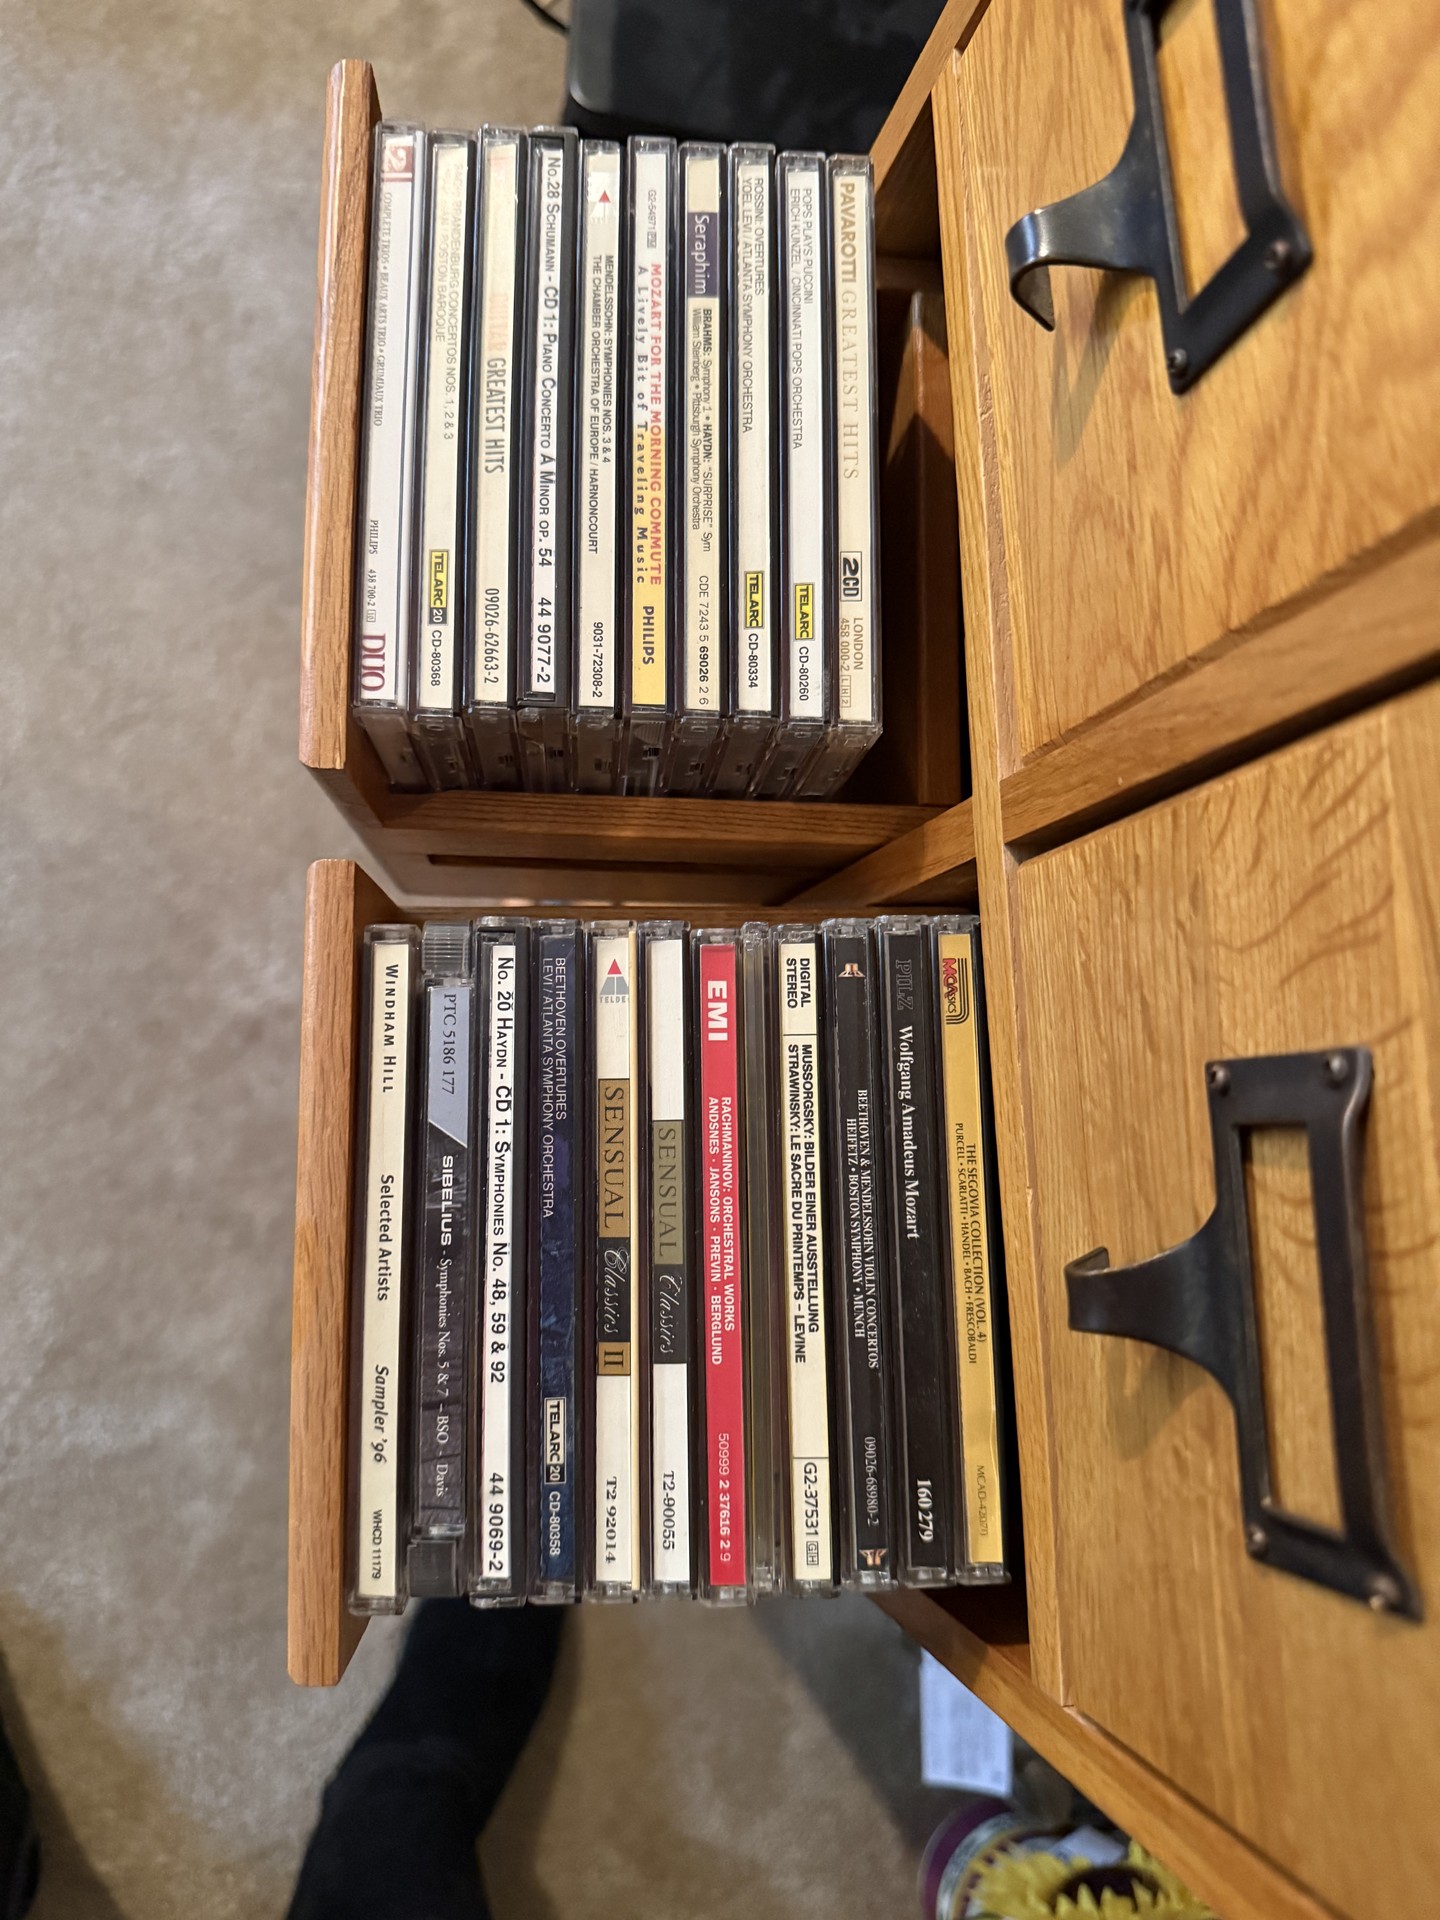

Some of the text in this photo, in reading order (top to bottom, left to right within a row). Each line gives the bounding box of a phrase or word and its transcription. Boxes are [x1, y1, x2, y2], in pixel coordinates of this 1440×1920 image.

[691, 214, 710, 294] Seraphim
[754, 178, 764, 296] ROSSINI: OVERTURES
[802, 188, 812, 304] POPS PLAYS PUCCINI
[544, 287, 558, 308] CD
[602, 255, 614, 407] MENDELSSOHN: SYMPHONIES
[703, 308, 712, 356] BRAHMS:
[742, 178, 752, 433] YOEL LEVI ATLANTA SYMPHONY ORCHESTRA
[790, 188, 802, 449] ERICH KUNZEL CINCINNATI POPS ORCHESTRA
[840, 182, 858, 480] PAVAROTTI GREATEST HITS
[484, 358, 506, 473] GREATEST HITS
[588, 278, 601, 554] CHAMBER ORCHESTRA EUROPE HARNONCOURT
[650, 263, 662, 585] MOZART MORNING COMMUTE
[690, 308, 702, 530] William Steinberg Pittsburgh Symphony Orchestra
[701, 360, 711, 404] Symphony
[634, 286, 648, 584] Lively Traveling Music
[703, 424, 712, 463] HAYDN:
[369, 520, 379, 555] PHILIPS
[538, 548, 553, 567] 54
[842, 557, 860, 597] 2CD
[367, 569, 377, 606] 438 700-2
[432, 552, 445, 623] TELARC 20
[699, 575, 709, 682] CDE 69026
[749, 574, 760, 627] TELARC
[799, 586, 809, 639] TELARC
[362, 633, 386, 692] DUO
[431, 630, 442, 687] CD-80368
[484, 588, 499, 684] 09026-62663-2
[537, 597, 552, 683] 44 9077-2
[592, 622, 604, 698] 9031-72308-2
[642, 606, 655, 665] PHILIPS
[747, 633, 758, 688] CD-80334
[798, 647, 809, 701] CD-80260
[840, 618, 850, 671] 458 000-2
[853, 618, 863, 670] LONDON
[707, 980, 728, 1042] EMI
[787, 958, 798, 1008] STEREO
[800, 958, 811, 1008] DIGITAL
[442, 994, 457, 1094] PTC 5186 177
[555, 958, 566, 1120] BEETHOVEN OVERTURES
[495, 1085, 511, 1112] CD
[542, 958, 554, 1218] LEVI ATLANTA SYMPHONY ORCHESTRA
[896, 1026, 919, 1239] Wolfgang Amadeus Mozart
[602, 1086, 630, 1366] SENSUAL Classics II
[708, 1097, 722, 1365] ANDSNES JANSONS PREVIN BERGLUND
[721, 1097, 735, 1331] RACHMANINOV: ORCHESTRAL WORKS
[788, 1044, 806, 1363] STRAWINSKY: SACRE PRINTEMPS LEVINE
[801, 1044, 819, 1333] MUSSORGSKY: BILDER EINER AUSSTELLUNG
[846, 1118, 864, 1338] HEIFETZ BOSTON SYMPHONY MUNCH
[857, 1089, 878, 1368] BEETHOVEN MENDELSSOHN VIOLIN CONCERTOS
[968, 1168, 985, 1295] SEGOVIA COLLECTION
[378, 1174, 394, 1301] Selected Artists
[658, 1128, 682, 1355] SENSUAL Classics
[955, 1123, 977, 1364] PURCELL SCARLATTI HANDEL BACH FRESCOBALDI
[436, 1155, 453, 1497] SIBELIUS Symphonies BSO Davis
[371, 1365, 389, 1434] Sampler
[549, 1401, 560, 1480] TELARC 20
[488, 1473, 503, 1571] 44 9069-2
[549, 1491, 561, 1555] CD-80358
[604, 1477, 618, 1564] T2 92014
[662, 1471, 676, 1551] T2-90055
[717, 1433, 731, 1535] 50999 37616
[804, 1463, 818, 1537] G2-37531
[864, 1437, 879, 1527] 09026-68980-2
[917, 1479, 933, 1542] 160 279
[371, 1510, 382, 1579] WHCD 11179
